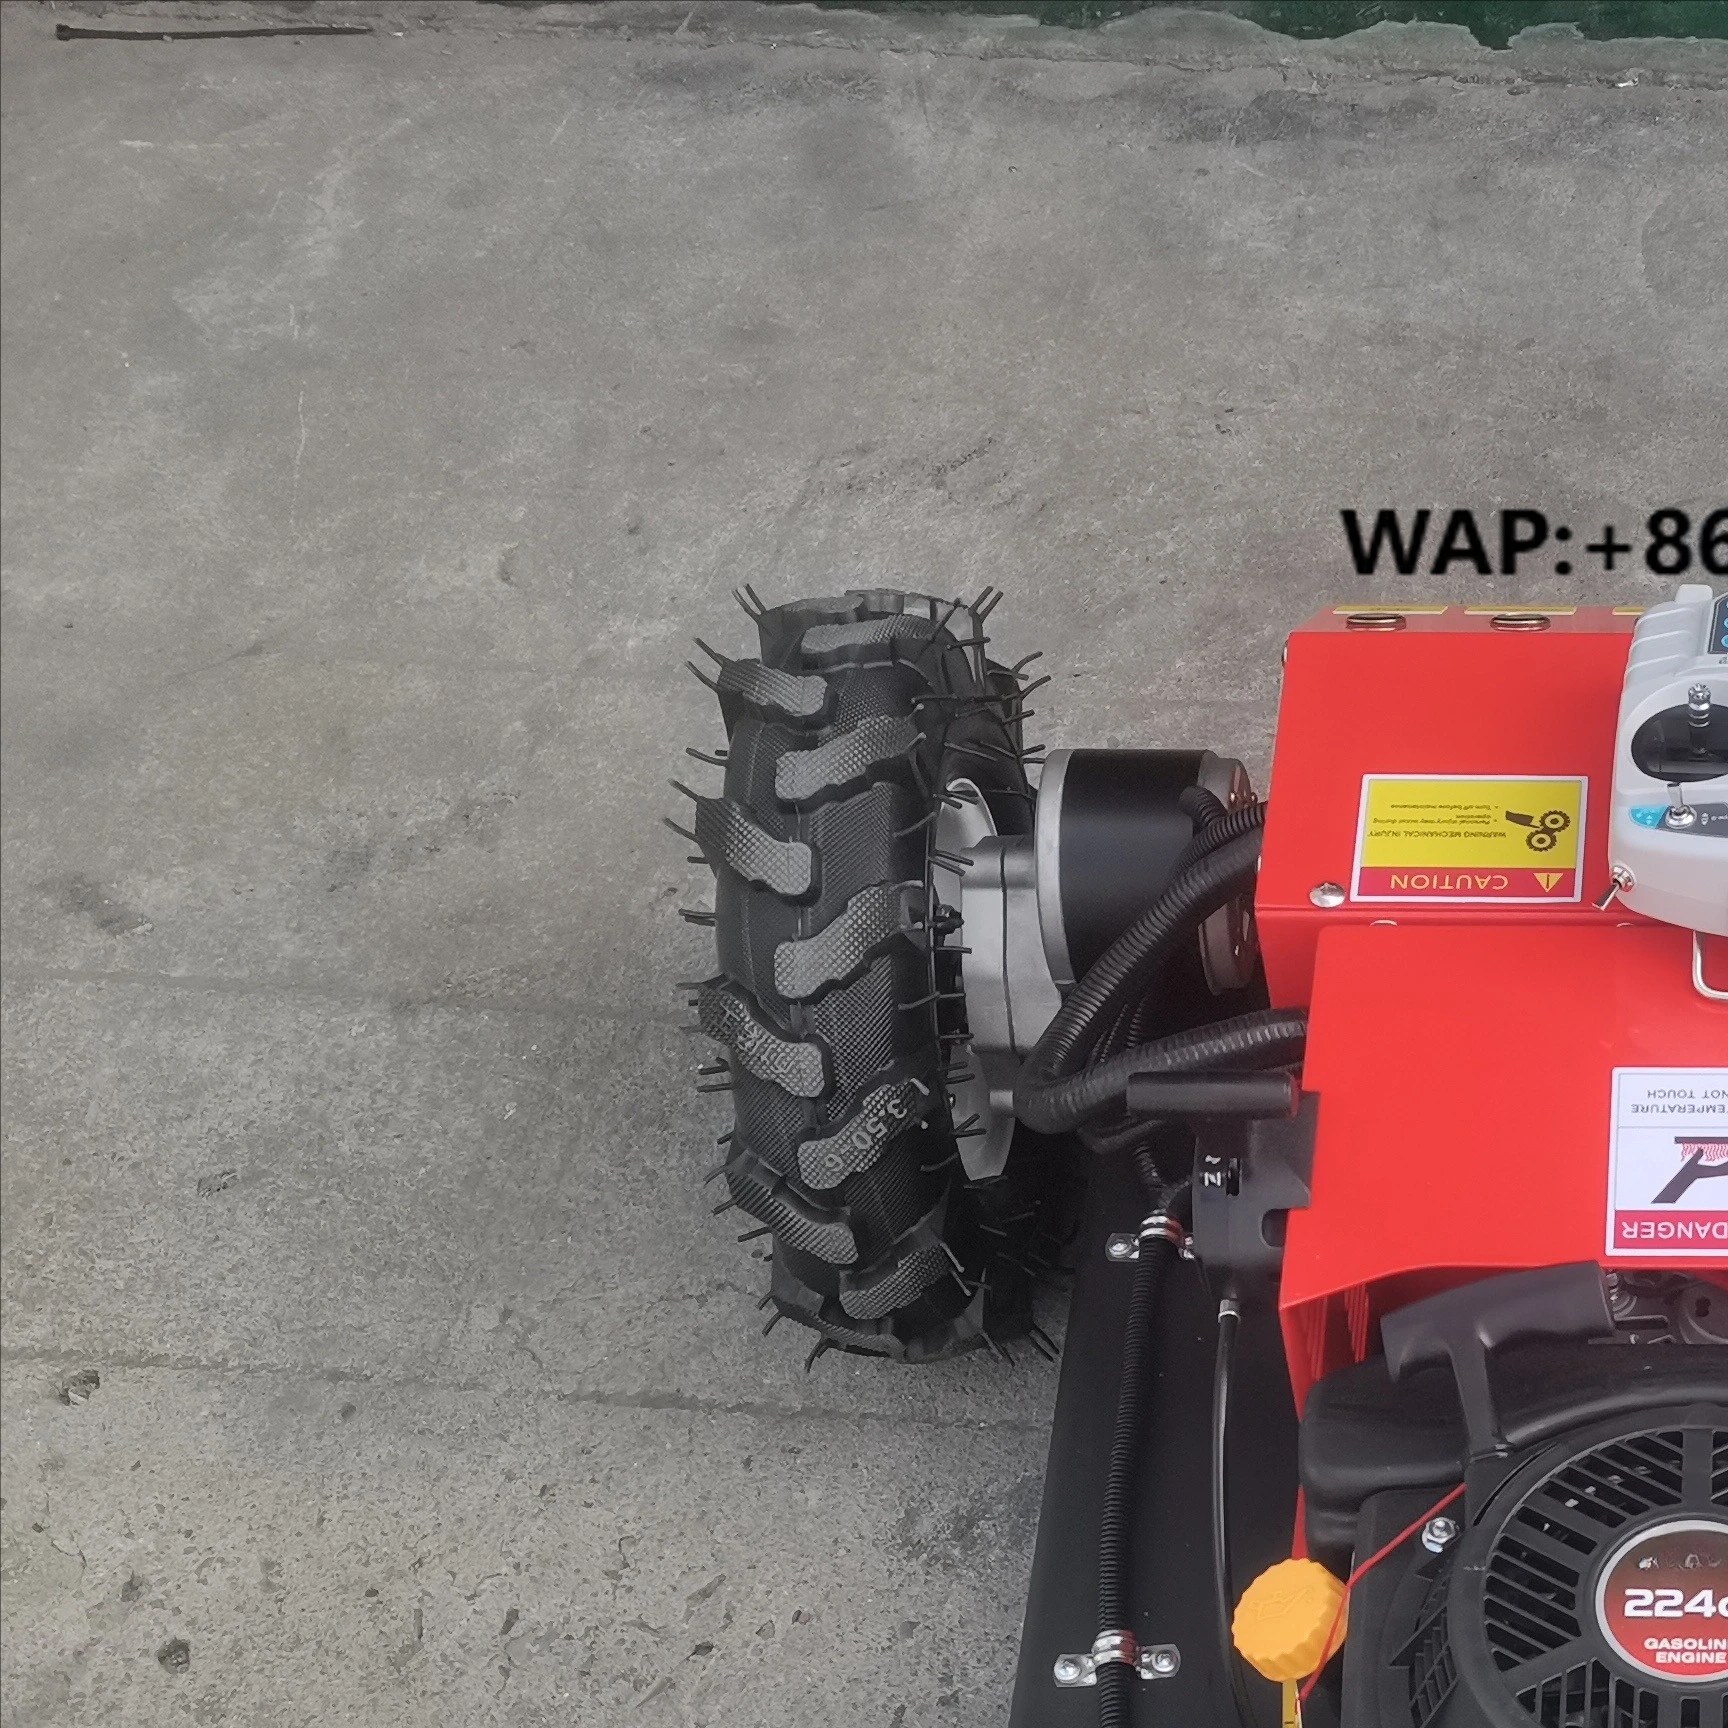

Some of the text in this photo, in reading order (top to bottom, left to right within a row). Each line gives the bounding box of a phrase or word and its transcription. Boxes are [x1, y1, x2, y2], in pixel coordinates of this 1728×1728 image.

[1403, 830, 1462, 838] MECHANICAL
[1390, 874, 1509, 890] CAUTION
[1646, 1089, 1696, 1100] TOUCH
[825, 1098, 908, 1172] 3.50-6
[1622, 1220, 1728, 1239] DANGER
[1655, 1651, 1728, 1664] ENGINE
